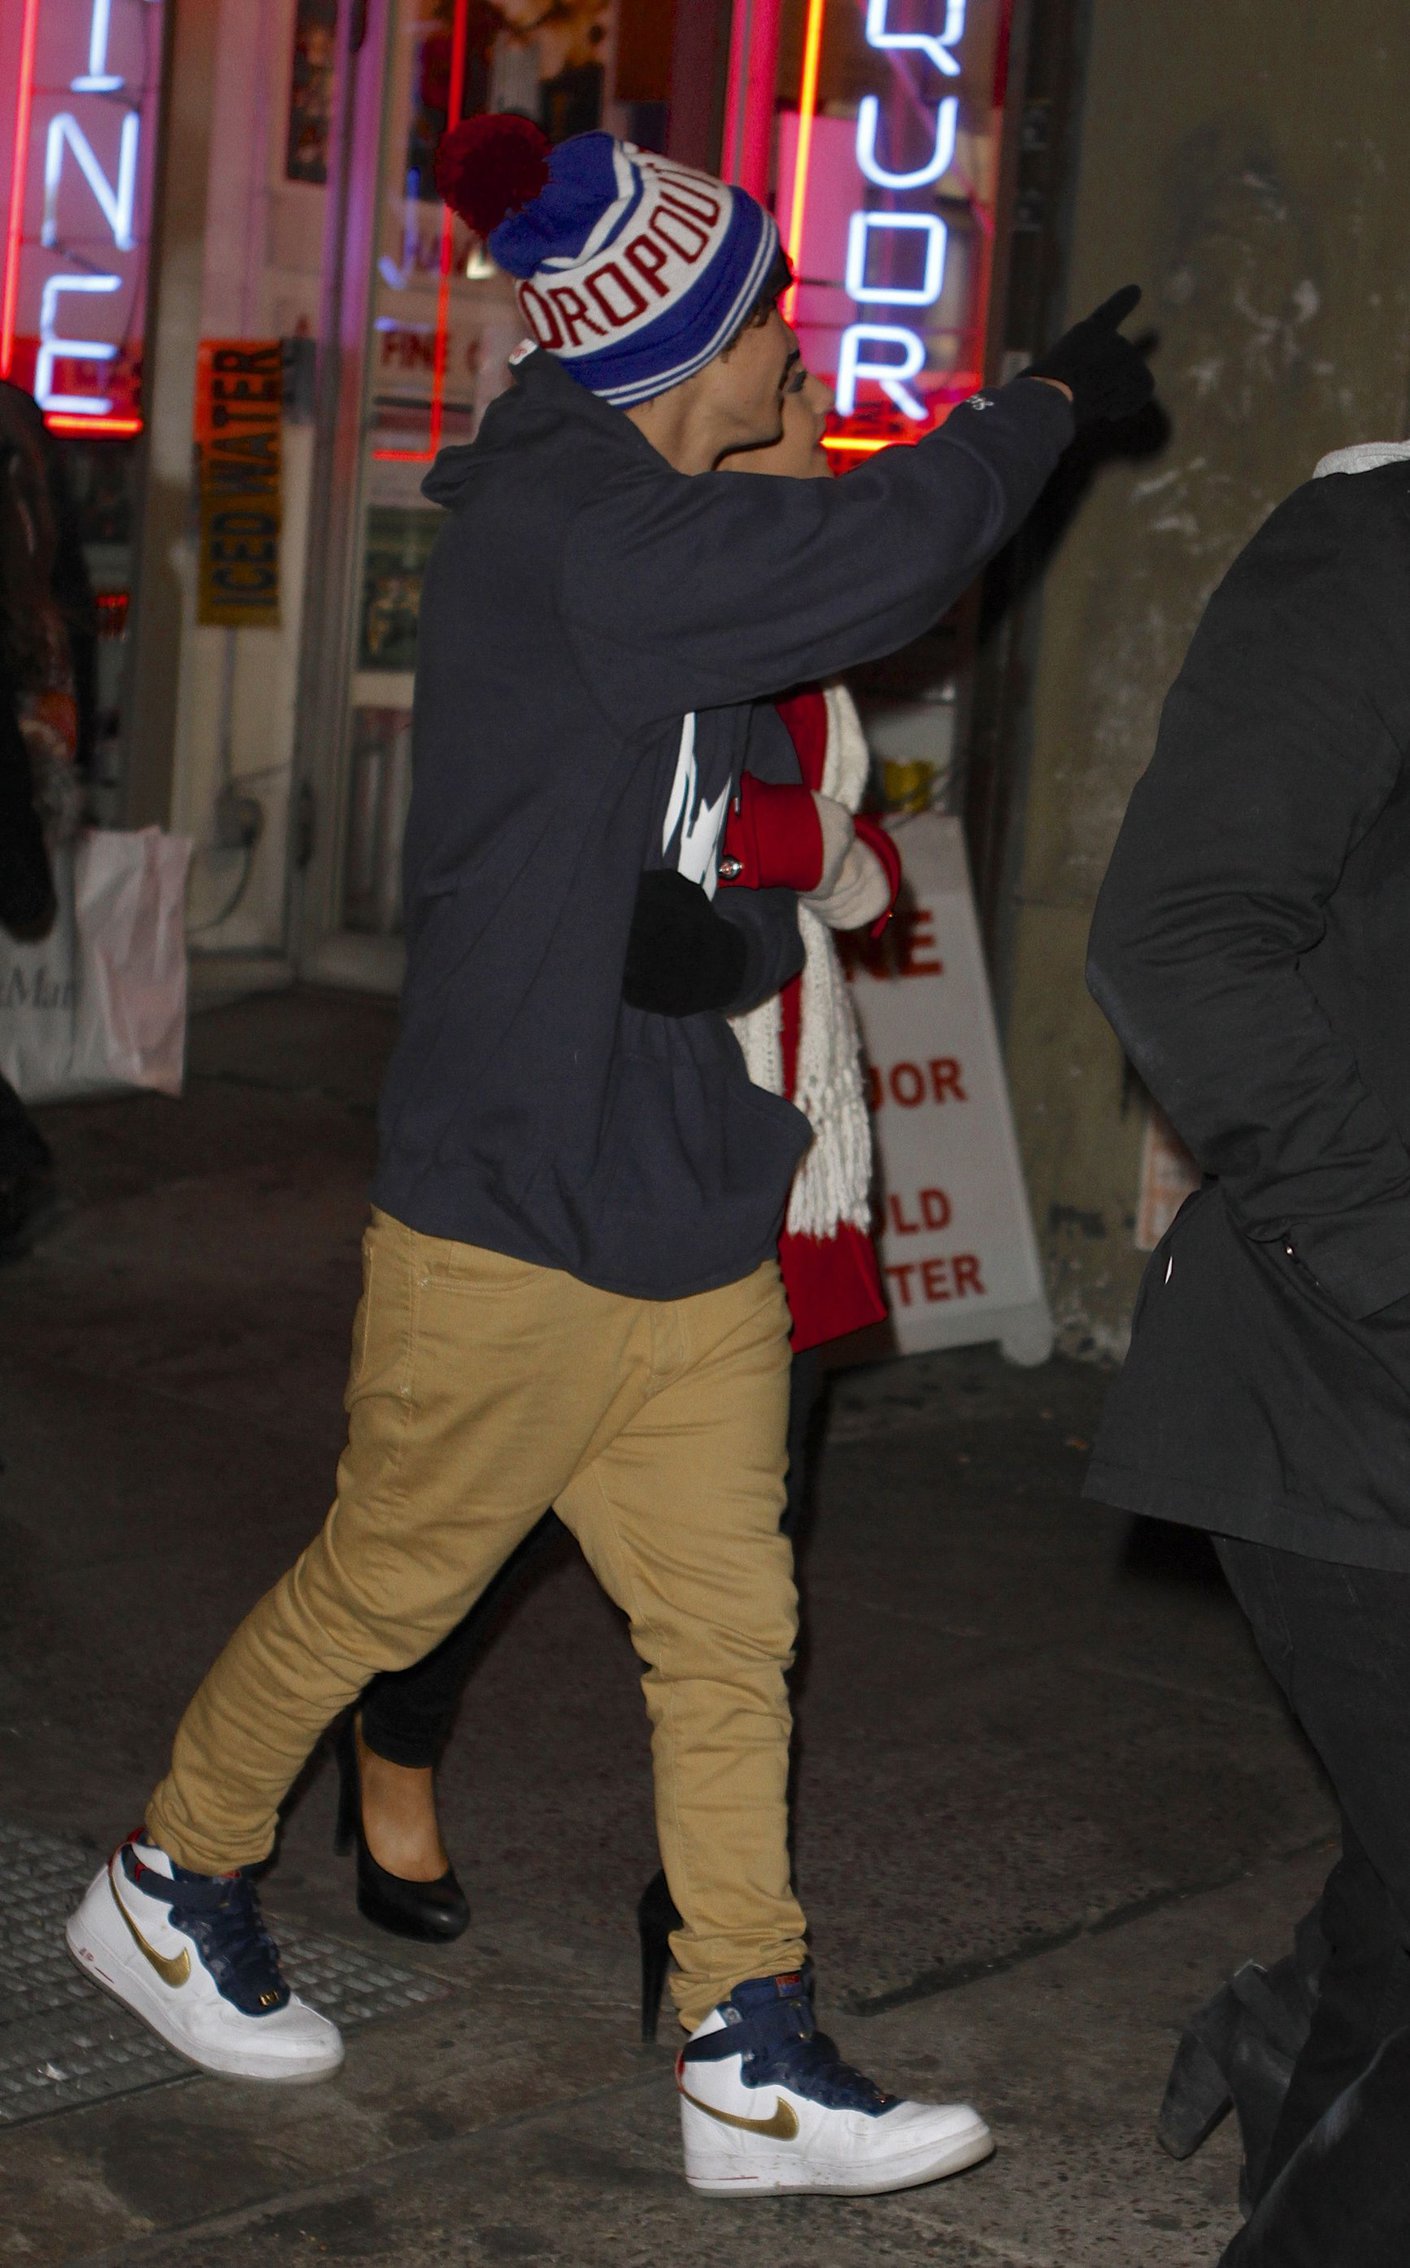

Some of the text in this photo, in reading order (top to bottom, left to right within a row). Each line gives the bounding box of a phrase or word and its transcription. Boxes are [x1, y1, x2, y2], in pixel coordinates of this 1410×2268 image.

[210, 344, 281, 604] ICED WATER
[884, 1254, 986, 1307] TER
